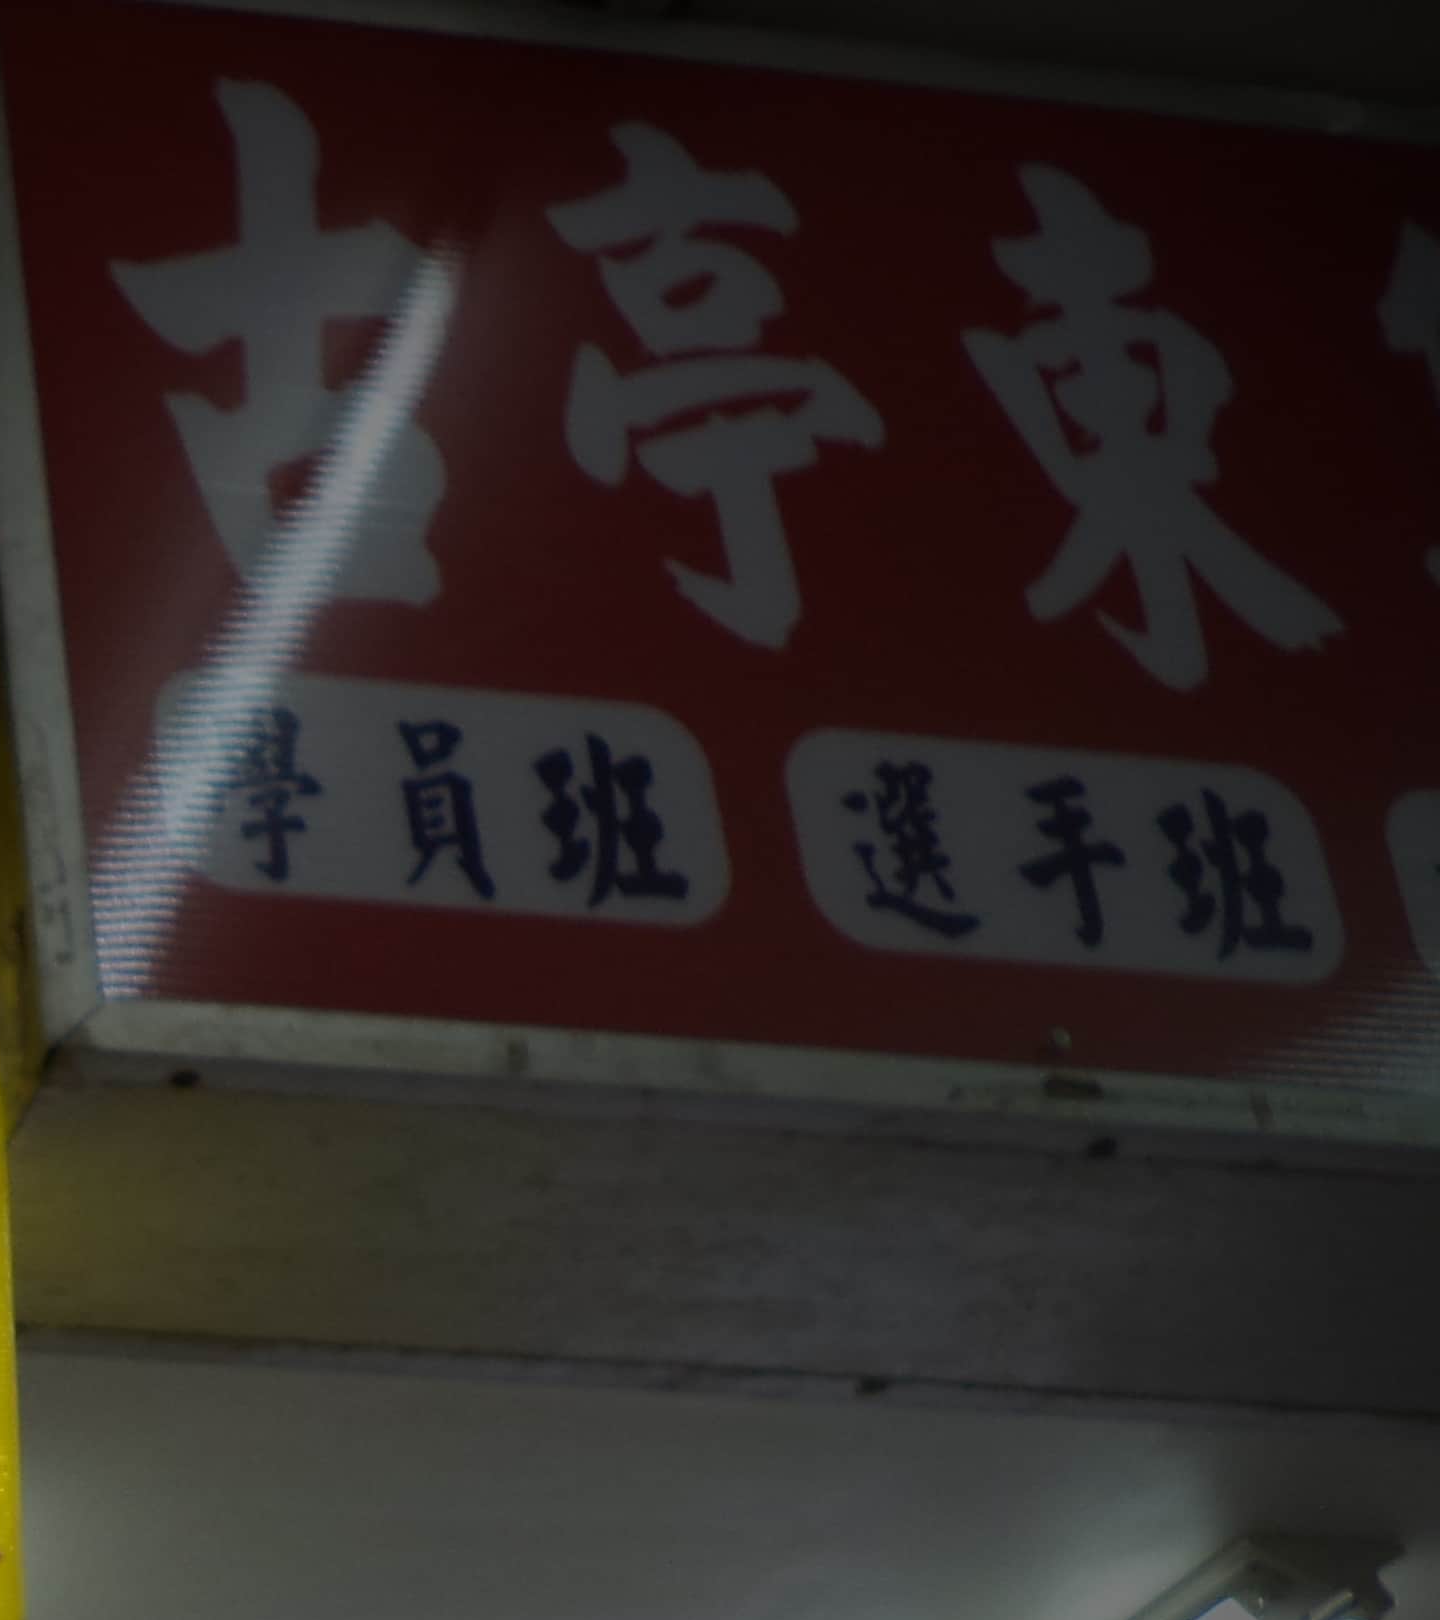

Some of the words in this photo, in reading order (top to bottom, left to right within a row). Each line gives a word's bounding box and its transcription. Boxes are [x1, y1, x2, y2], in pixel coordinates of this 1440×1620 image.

[108, 75, 1440, 692] 古亭東
[228, 706, 689, 908] 學員班
[844, 757, 1316, 961] 選手班
